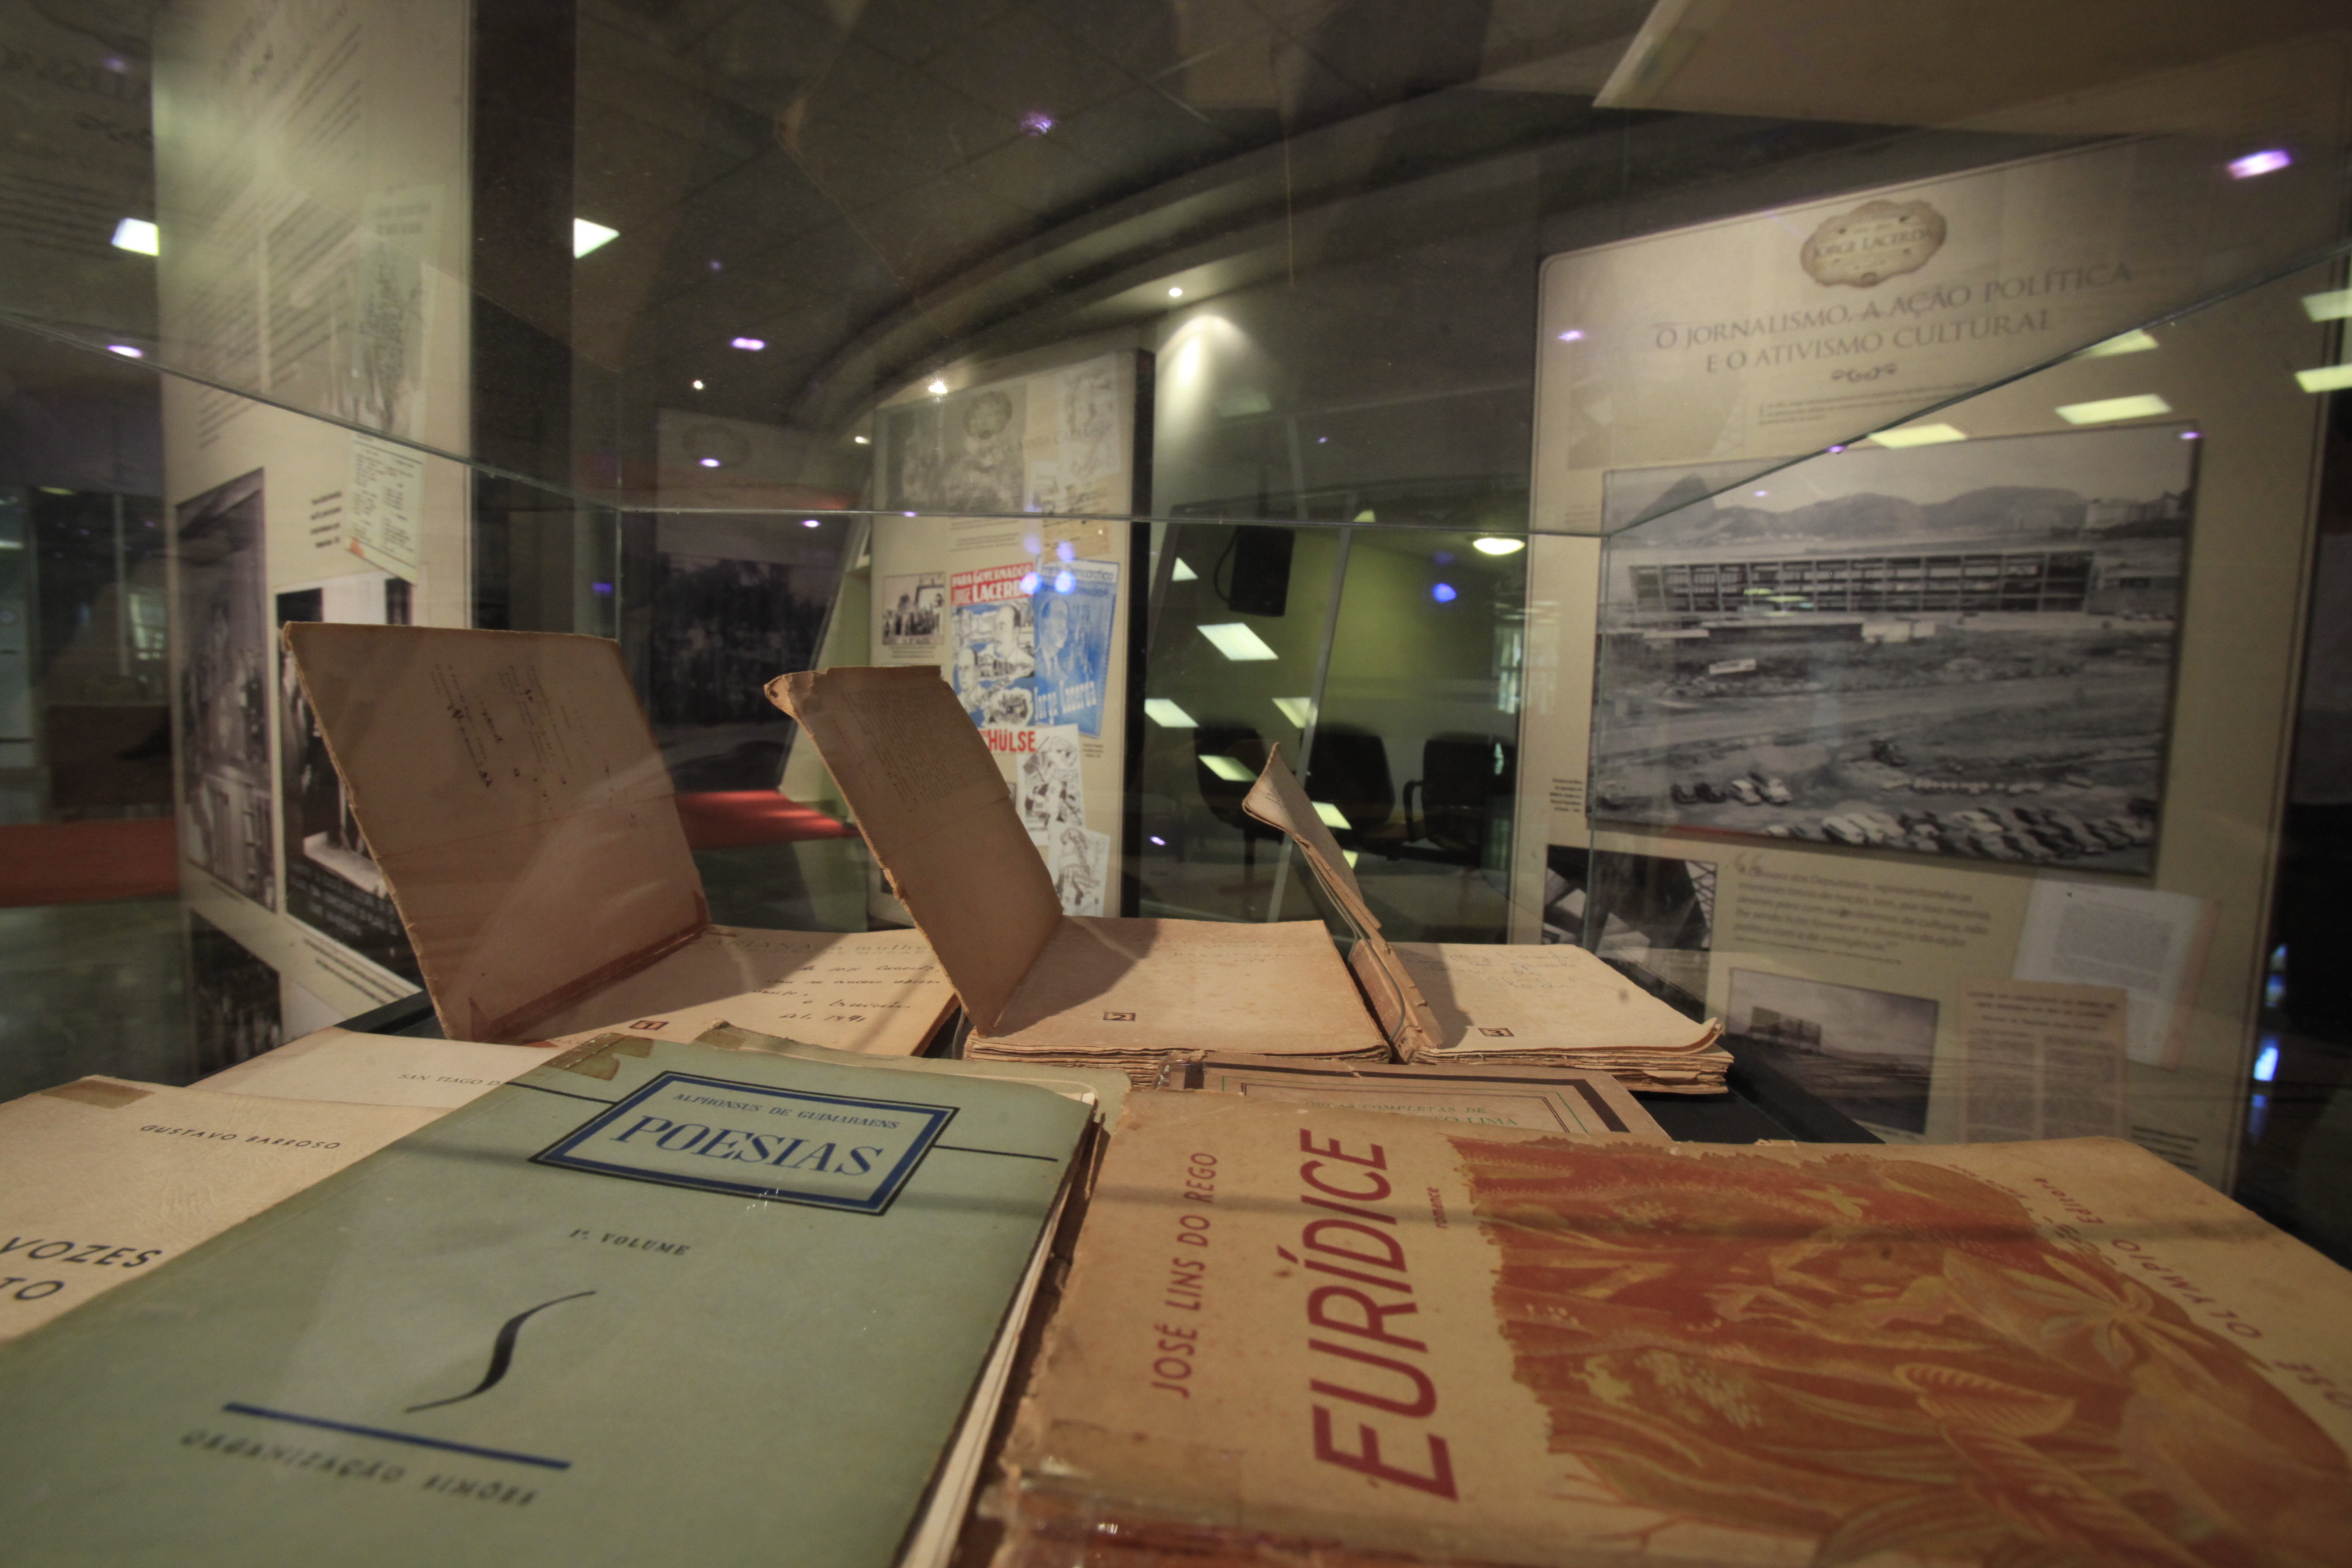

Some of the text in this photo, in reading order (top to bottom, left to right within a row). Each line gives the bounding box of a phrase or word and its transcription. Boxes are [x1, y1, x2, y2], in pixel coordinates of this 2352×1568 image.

[1656, 327, 1678, 350] O
[1862, 300, 1880, 321] A
[1891, 284, 1972, 318] AÇÃO
[1985, 263, 2131, 303] POLÍTICA
[1706, 309, 2055, 373] E O ATIVISMO CULTURAL
[972, 576, 1031, 603] LACERD
[987, 728, 1037, 753] HÜLSE
[436, 1076, 484, 1085] TIAGO
[672, 1093, 900, 1130] ALPHONSUS DE GUIMARAENS
[1363, 1104, 1457, 1113] COMPLETAS
[140, 1124, 342, 1151] GUSTAVO BARROSO
[609, 1113, 885, 1179] POESIAS
[1427, 1186, 1449, 1230] romance
[2033, 1177, 2106, 1224] Editora
[0, 1237, 163, 1268] VOZES
[601, 1231, 691, 1256] VOLUME
[1151, 1152, 1219, 1399] JOSÉ LINS DO REGO
[2110, 1239, 2263, 1339] OLYMPIO
[1276, 1128, 1460, 1502] EURÍDICE
